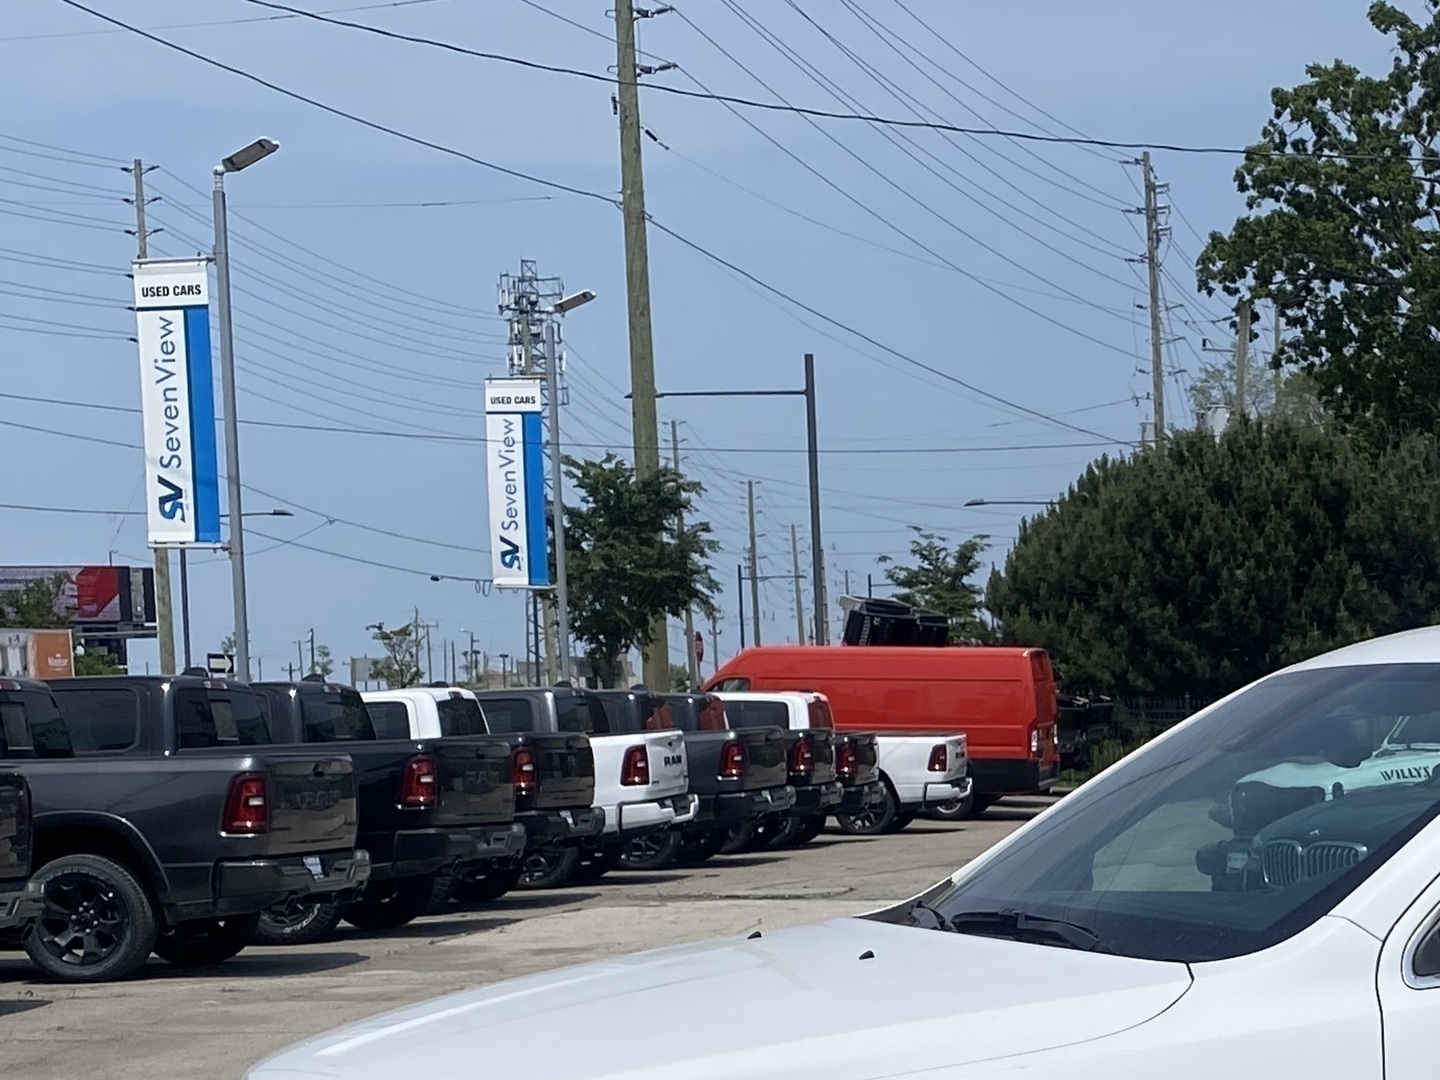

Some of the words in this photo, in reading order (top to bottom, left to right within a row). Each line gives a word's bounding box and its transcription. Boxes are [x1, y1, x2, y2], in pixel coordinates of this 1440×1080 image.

[141, 286, 170, 298] USED
[172, 284, 202, 296] CARS
[154, 316, 176, 386] View
[490, 396, 512, 405] USED
[514, 395, 536, 405] CARS
[159, 387, 182, 469] Seven
[499, 418, 515, 469] View
[157, 474, 186, 523] SV
[501, 471, 519, 531] Seven
[499, 534, 522, 571] SV
[1379, 766, 1431, 781] WILLYS
